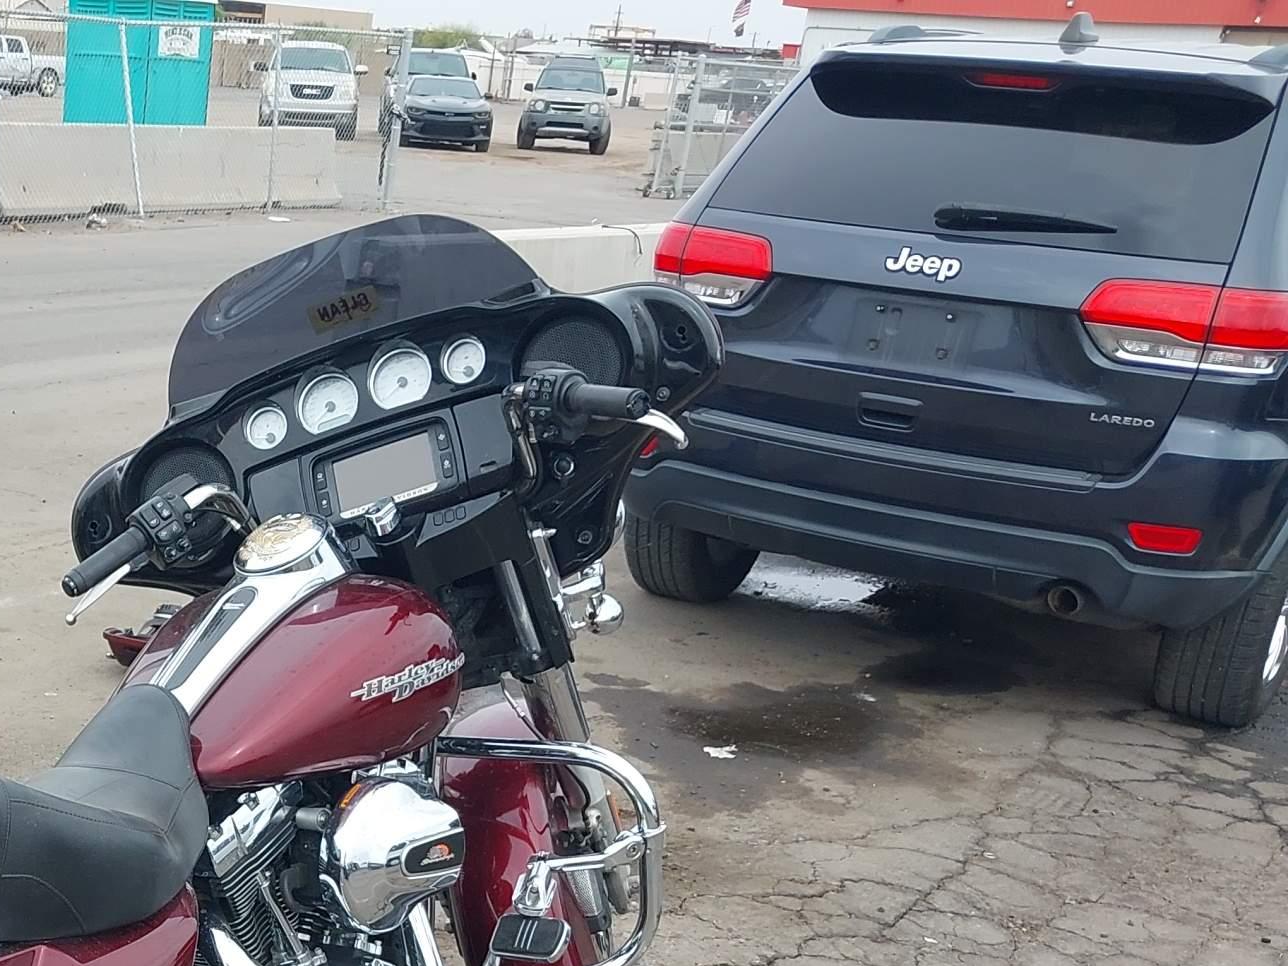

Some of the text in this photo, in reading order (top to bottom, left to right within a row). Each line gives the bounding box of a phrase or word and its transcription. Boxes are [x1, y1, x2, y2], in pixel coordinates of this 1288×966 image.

[884, 246, 962, 282] Jeep
[1089, 412, 1155, 428] LAREDO
[351, 657, 445, 701] Harley
